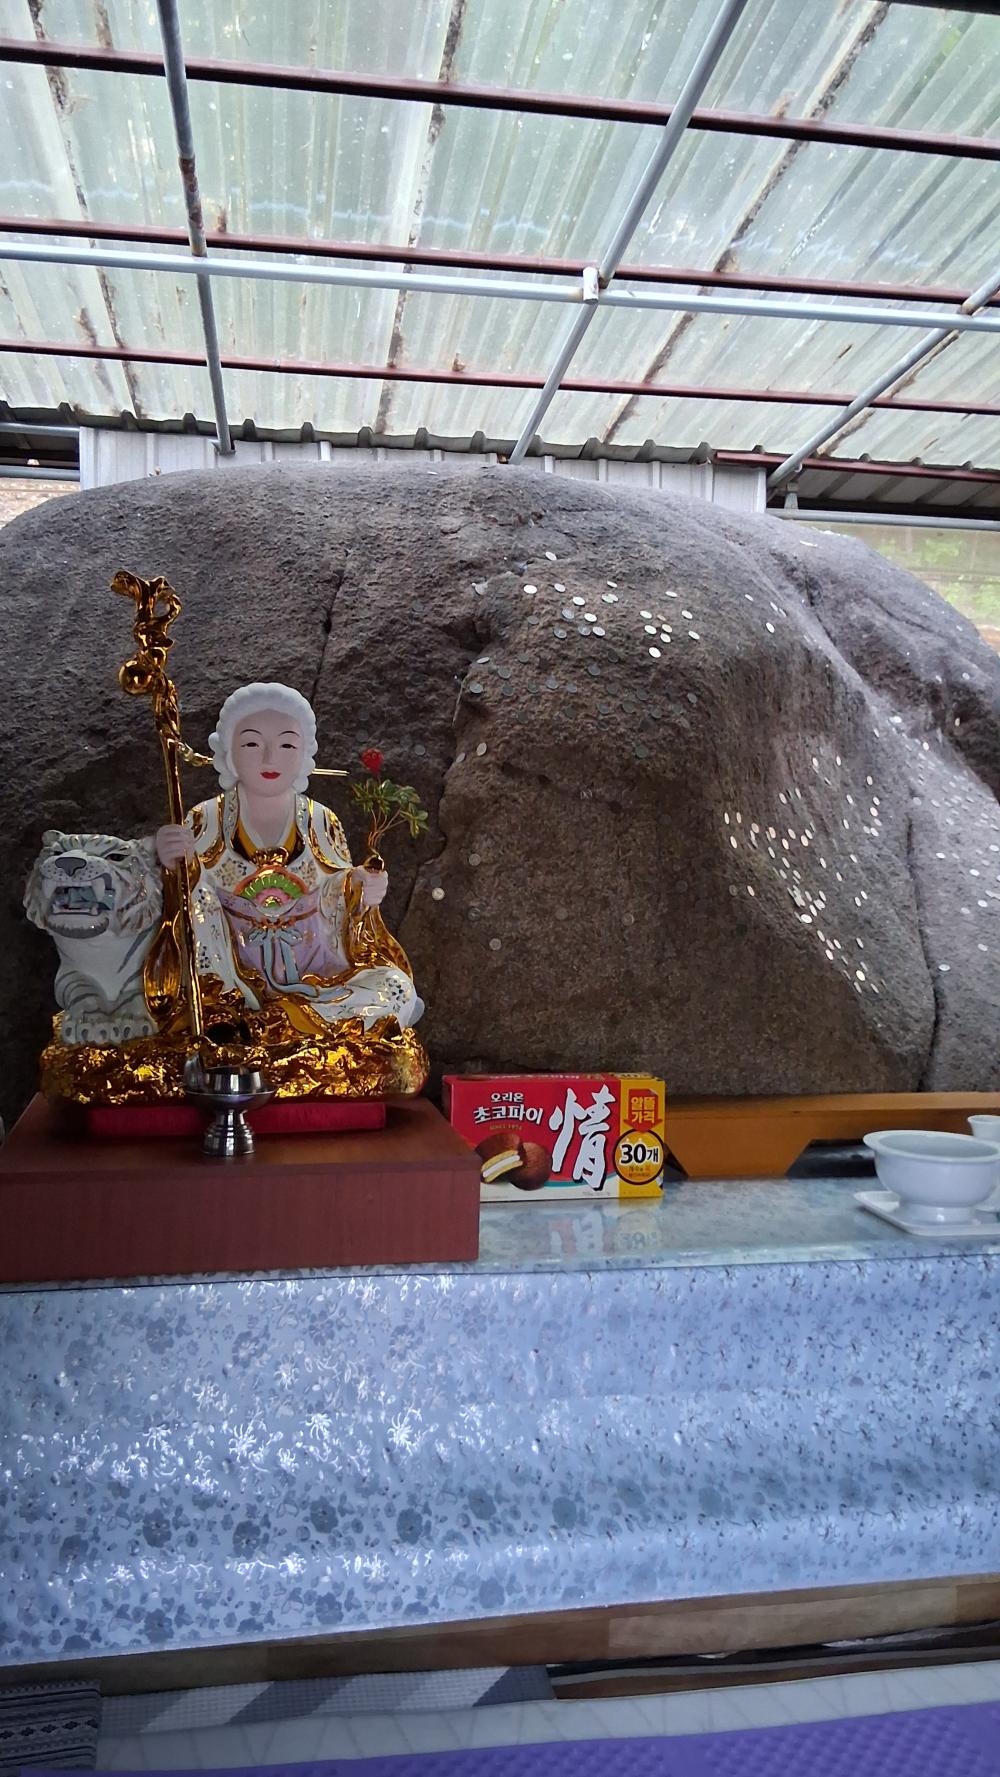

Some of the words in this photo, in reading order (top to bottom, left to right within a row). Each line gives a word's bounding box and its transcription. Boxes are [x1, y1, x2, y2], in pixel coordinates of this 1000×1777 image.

[491, 1092, 524, 1103] 오리온
[631, 1096, 655, 1110] 알뜰
[473, 1104, 544, 1125] 초코파이
[631, 1110, 655, 1124] 가격
[548, 1083, 616, 1191] 情
[620, 1143, 659, 1164] 30개
